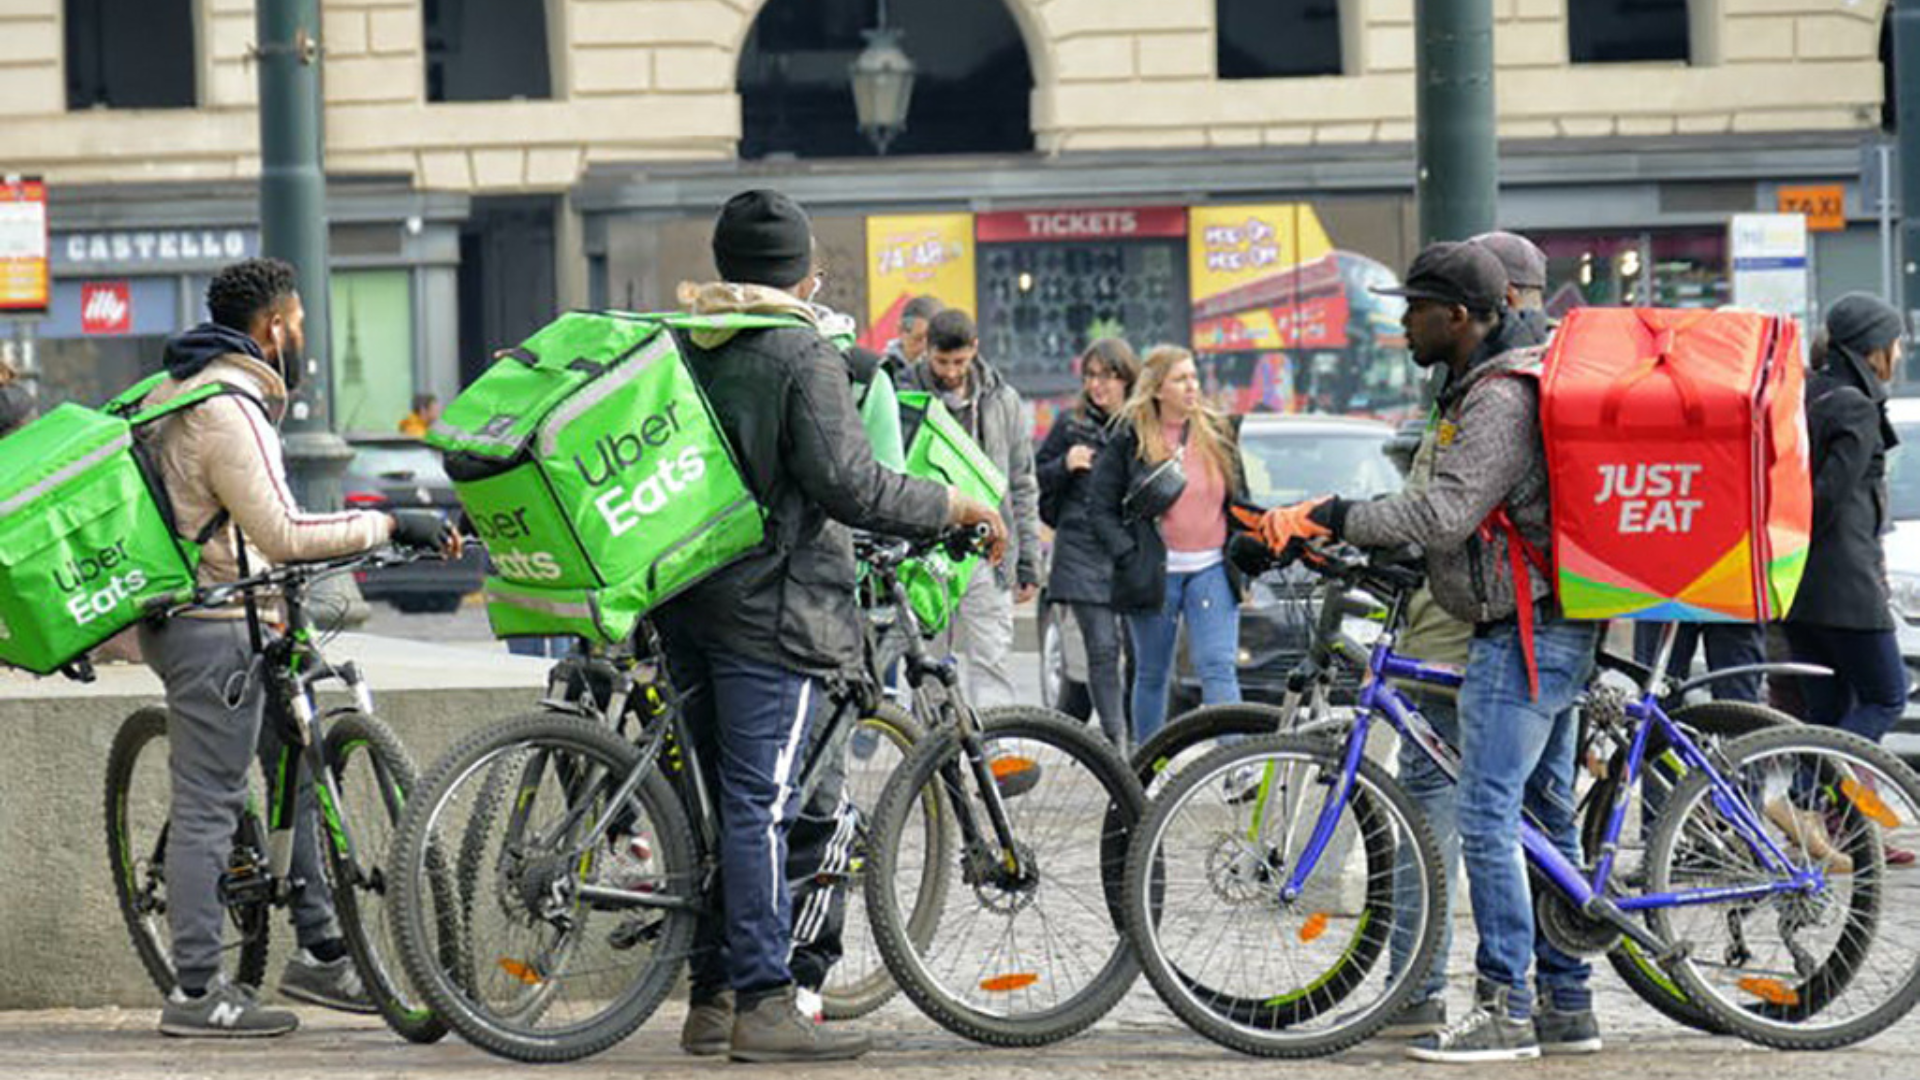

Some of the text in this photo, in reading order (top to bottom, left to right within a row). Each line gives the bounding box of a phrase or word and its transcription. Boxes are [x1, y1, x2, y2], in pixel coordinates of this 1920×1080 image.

[1026, 211, 1137, 234] TICKETS
[1784, 196, 1841, 216] TAXI
[66, 231, 245, 262] CASTELLO
[84, 288, 127, 325] illy
[574, 400, 683, 487] Uber
[595, 445, 705, 536] Eats
[1593, 463, 1703, 505] JUST
[1617, 499, 1704, 534] EAT
[52, 537, 128, 593] Uber
[490, 546, 562, 580] ats
[66, 568, 147, 626] Eats
